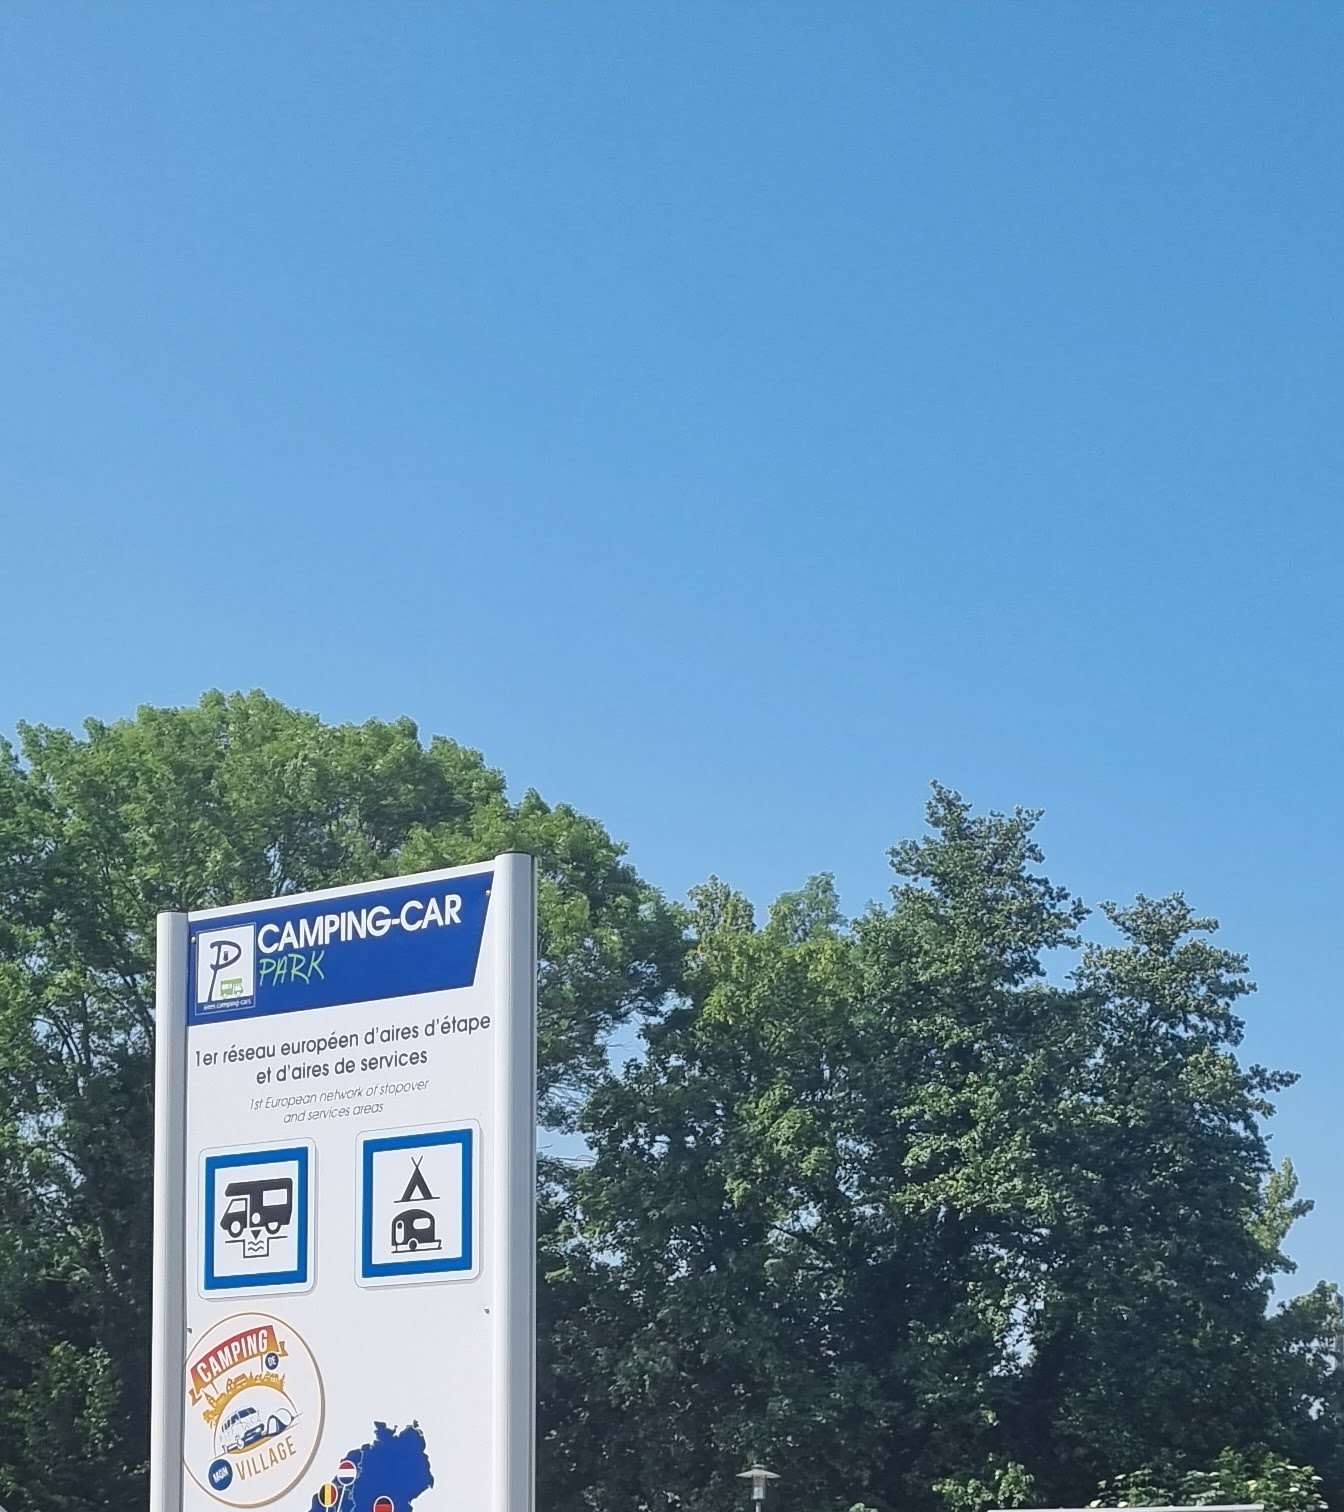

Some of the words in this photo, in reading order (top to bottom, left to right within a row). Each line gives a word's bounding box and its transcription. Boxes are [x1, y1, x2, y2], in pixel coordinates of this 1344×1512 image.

[257, 894, 462, 954] CAMPING-CAR
[259, 949, 325, 987] PARK
[196, 1050, 218, 1067] 1er
[223, 1044, 276, 1064] réseau
[281, 1031, 359, 1055] européen
[364, 1025, 420, 1045] d'aires
[424, 1015, 491, 1037] d'étape
[256, 1066, 271, 1084] et
[276, 1062, 330, 1082] d'aires
[334, 1057, 356, 1075] de
[360, 1050, 429, 1072] services
[250, 1098, 264, 1110] 1st
[265, 1093, 317, 1112] European
[320, 1086, 363, 1102] network
[366, 1084, 378, 1097] of
[379, 1079, 429, 1097] stopover
[283, 1110, 306, 1124] and
[308, 1105, 350, 1121] services
[353, 1103, 384, 1116] areas
[196, 1329, 269, 1383] CAMPING
[236, 1436, 297, 1481] VILLAGE
